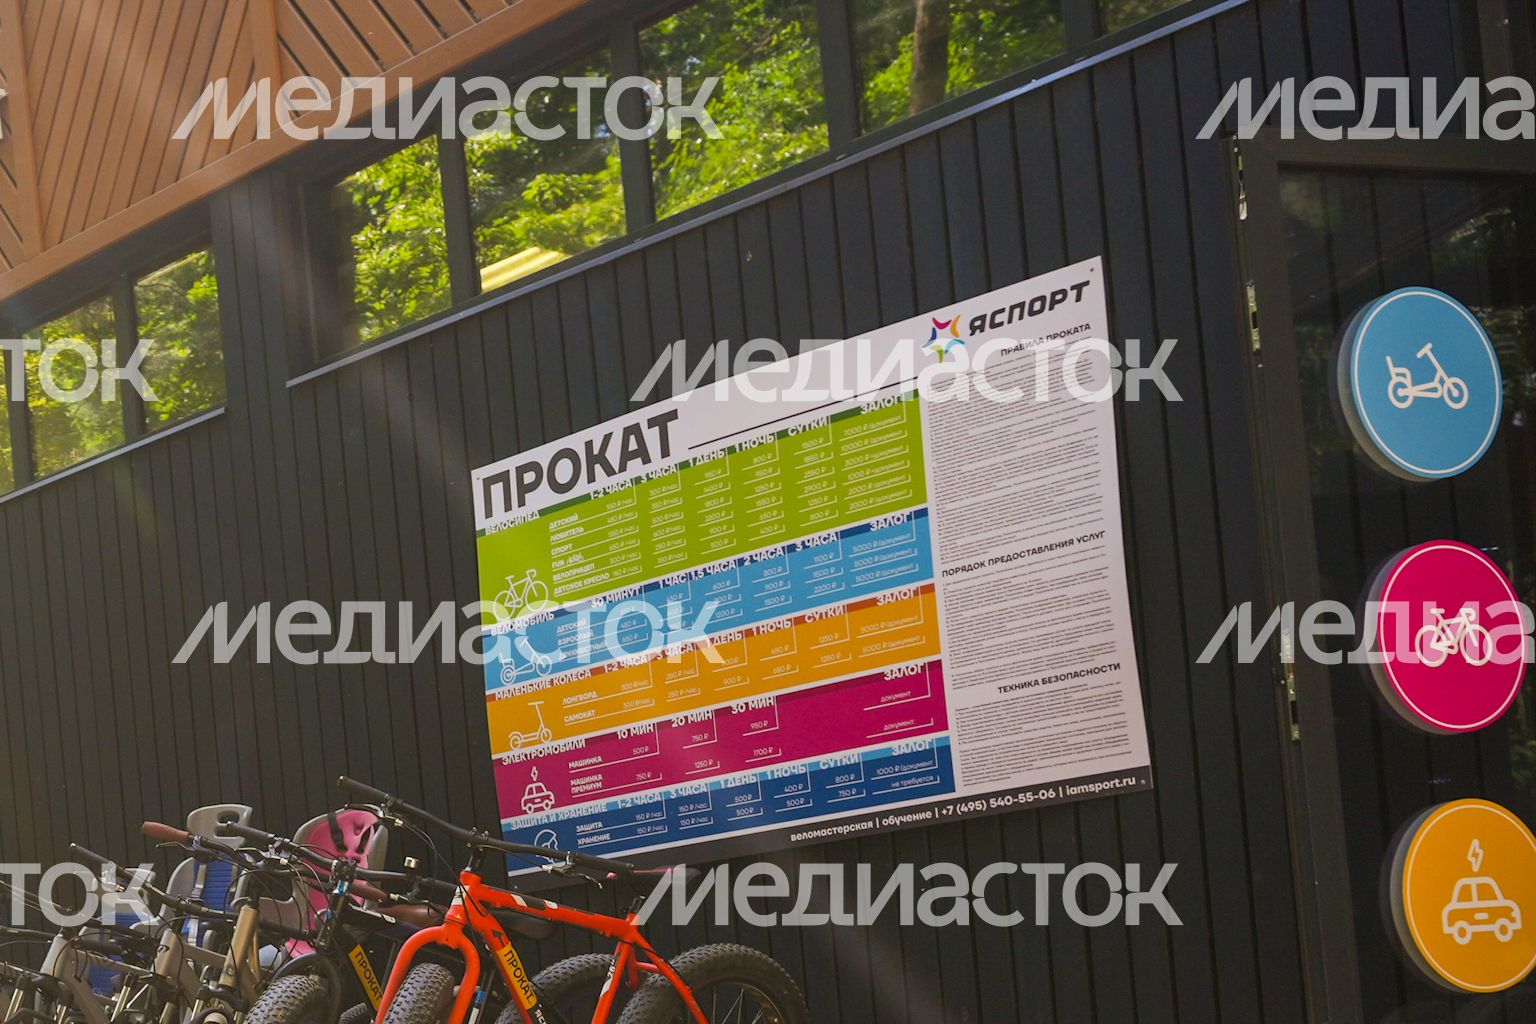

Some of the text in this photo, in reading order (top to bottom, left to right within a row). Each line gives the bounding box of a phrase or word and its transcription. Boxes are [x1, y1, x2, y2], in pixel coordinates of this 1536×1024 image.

[969, 280, 1090, 336] ЯСПОРТ
[1000, 323, 1091, 357] ПРАВИЛА ПРОКАТА
[482, 408, 679, 520] ПРОКАТ
[484, 510, 540, 536] ВЕЛОСИПЕД
[590, 490, 604, 500] 1-2
[605, 478, 633, 494] ЧАСА
[649, 464, 677, 480] ЧАСА
[696, 450, 726, 466] ДЕНЬ
[743, 433, 774, 451] НОЧЬ
[788, 416, 829, 437] СУТКИ
[860, 394, 901, 415] ЗАЛОГ
[491, 611, 555, 636] ВЕЛОМОБИЛЬ
[591, 599, 604, 609] 30
[605, 587, 642, 604] МИНУТ
[666, 574, 688, 586] ЧАС
[691, 570, 704, 581] 1,5
[706, 561, 736, 574] ЧАСА
[753, 547, 784, 562] ЧАСА
[805, 532, 837, 548] ЧАСА
[870, 512, 912, 532] ЗАЛОГ
[942, 530, 1106, 578] ПОРЯДОК ПРЕДОСТАВЛЕНИЯ УСЛУГ
[495, 680, 552, 700] МАЛЕНЬКИЕ
[552, 670, 592, 686] КОЛЕСА
[604, 664, 618, 674] 1-2
[620, 655, 648, 669] ЧАСА
[666, 643, 694, 658] ЧАСА
[714, 632, 743, 646] ДЕНЬ
[760, 618, 792, 634] НОЧЬ
[805, 605, 846, 624] СУТКИ
[876, 586, 918, 606] ЗАЛОГ
[998, 663, 1121, 694] ТЕХНИКА БЕЗОПАСНОСТИ
[502, 663, 926, 766] ЭЛЕКТРОМОБИЛИ 10 МИН 20 МИН 30 МИН ЗАЛОГ
[564, 710, 596, 722] САМОКАТ
[510, 814, 548, 830] ЗАЩИТА
[558, 802, 607, 821] ХРАНЕНИЕ
[617, 799, 632, 809] 1-2
[634, 793, 662, 806] ЧАСА
[679, 783, 708, 797] ЧАСА
[728, 773, 757, 786] ДЕНЬ
[774, 764, 806, 777] НОЧЬ
[820, 753, 860, 769] СУТКИ
[891, 739, 932, 756] ЗАЛОГ
[568, 756, 602, 769] МАШИНКА
[570, 774, 603, 786] МАШИНКА
[576, 822, 603, 833] ЗАЩИТА
[791, 775, 1136, 842] веломастерская обучение +7 (495) 540-55-06 iamsport.ru
[577, 834, 610, 846] ХРАНЕНИЕ
[354, 951, 382, 1002] ПРОКАТ
[504, 950, 536, 1002] ПРОКАТ
